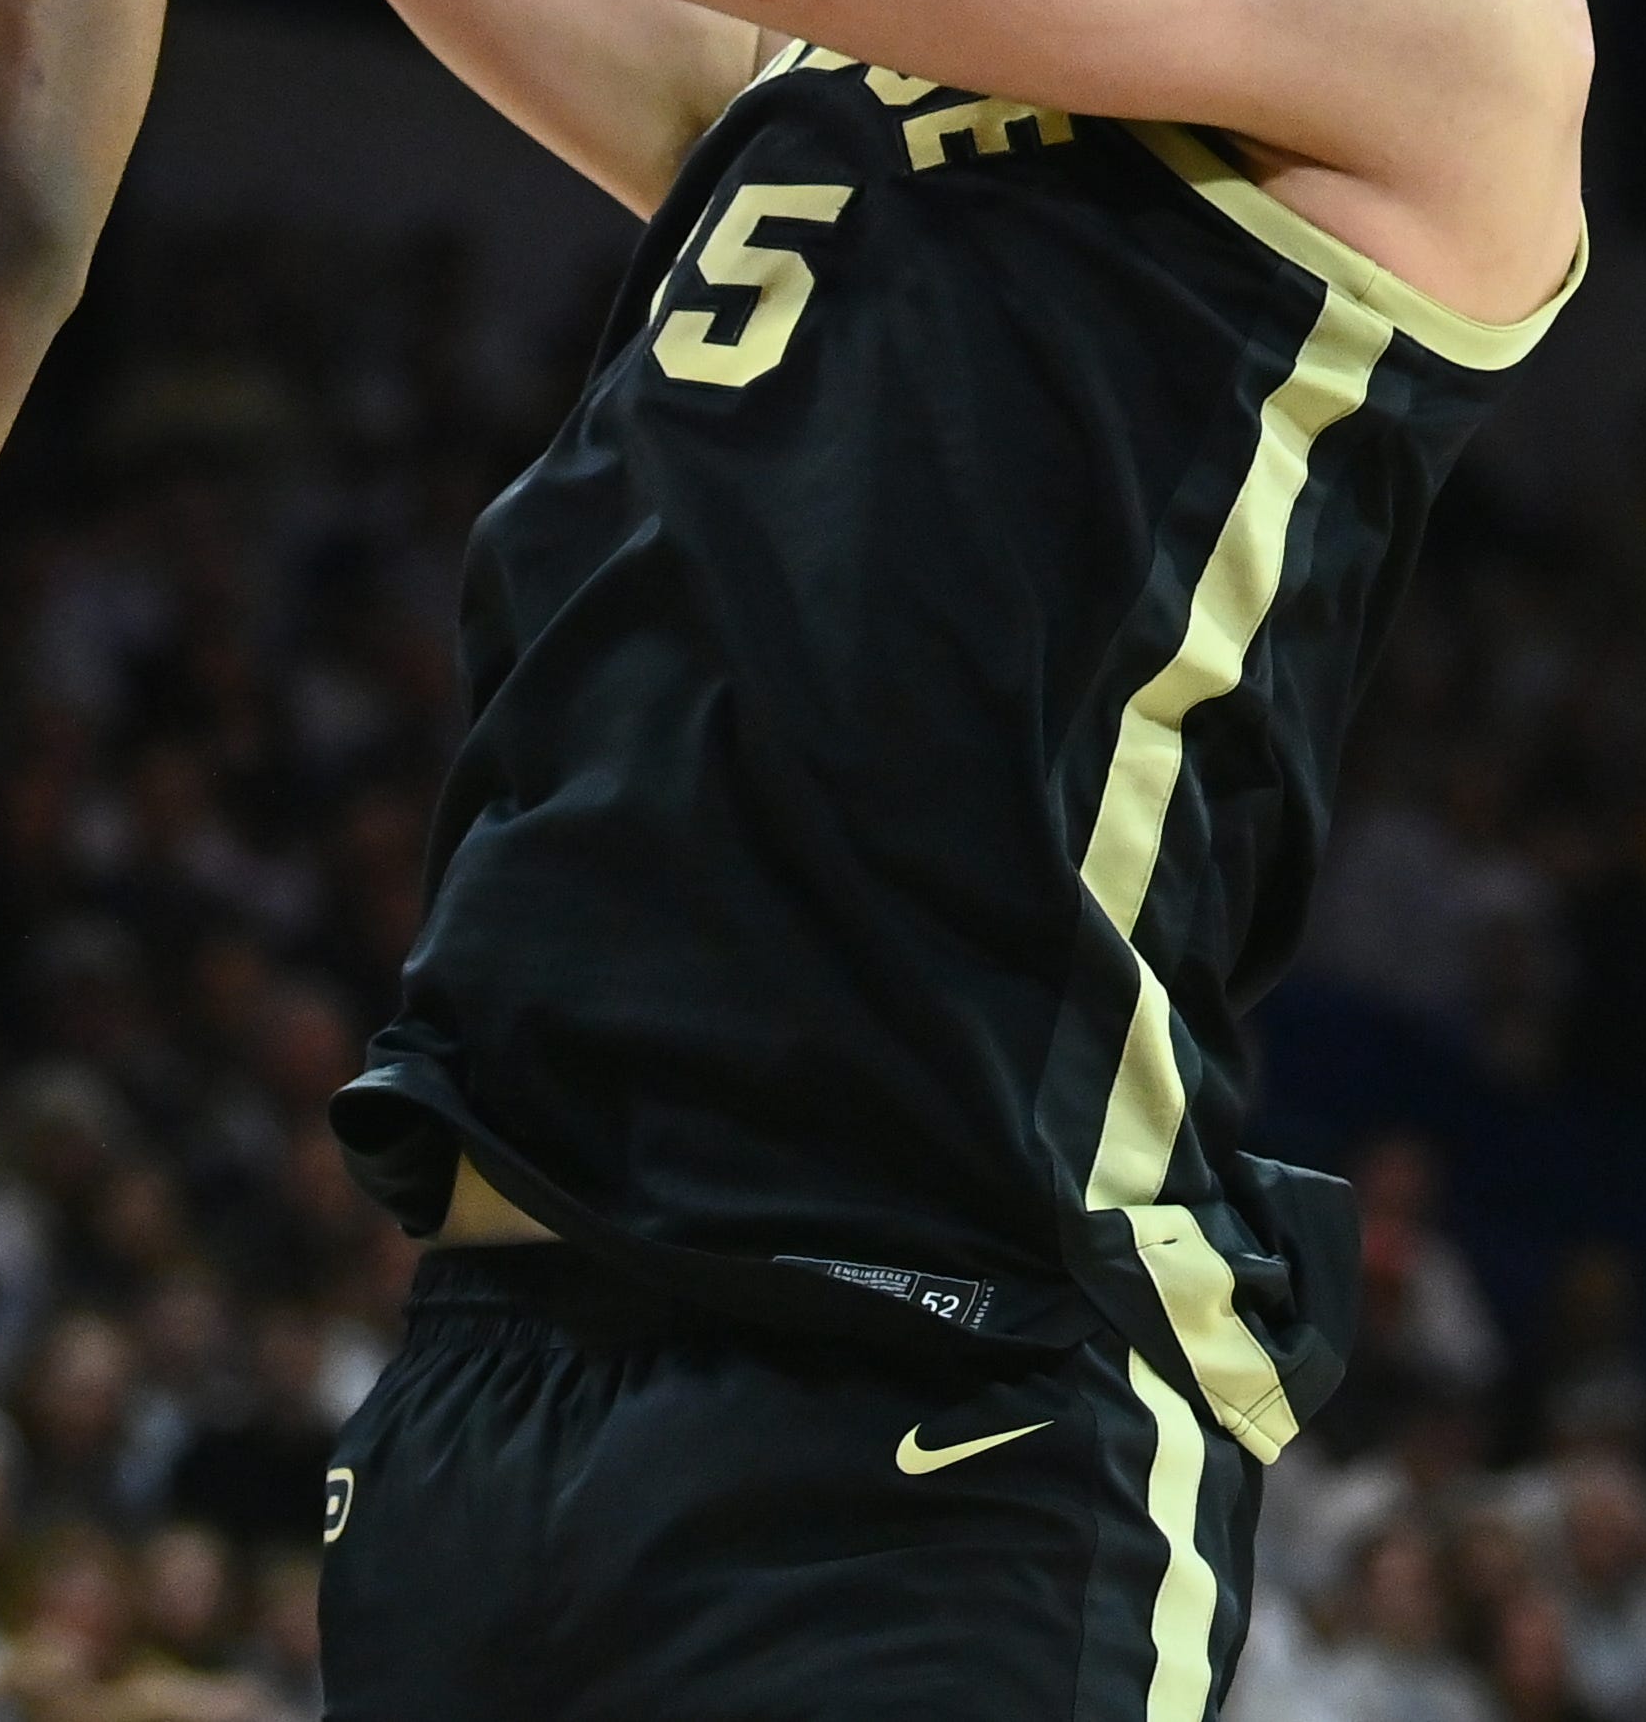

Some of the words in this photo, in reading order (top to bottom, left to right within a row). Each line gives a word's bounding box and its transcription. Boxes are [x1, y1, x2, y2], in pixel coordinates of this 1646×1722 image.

[648, 184, 855, 389] 5
[834, 1265, 912, 1283] ENGINEERED
[921, 1290, 960, 1318] 52
